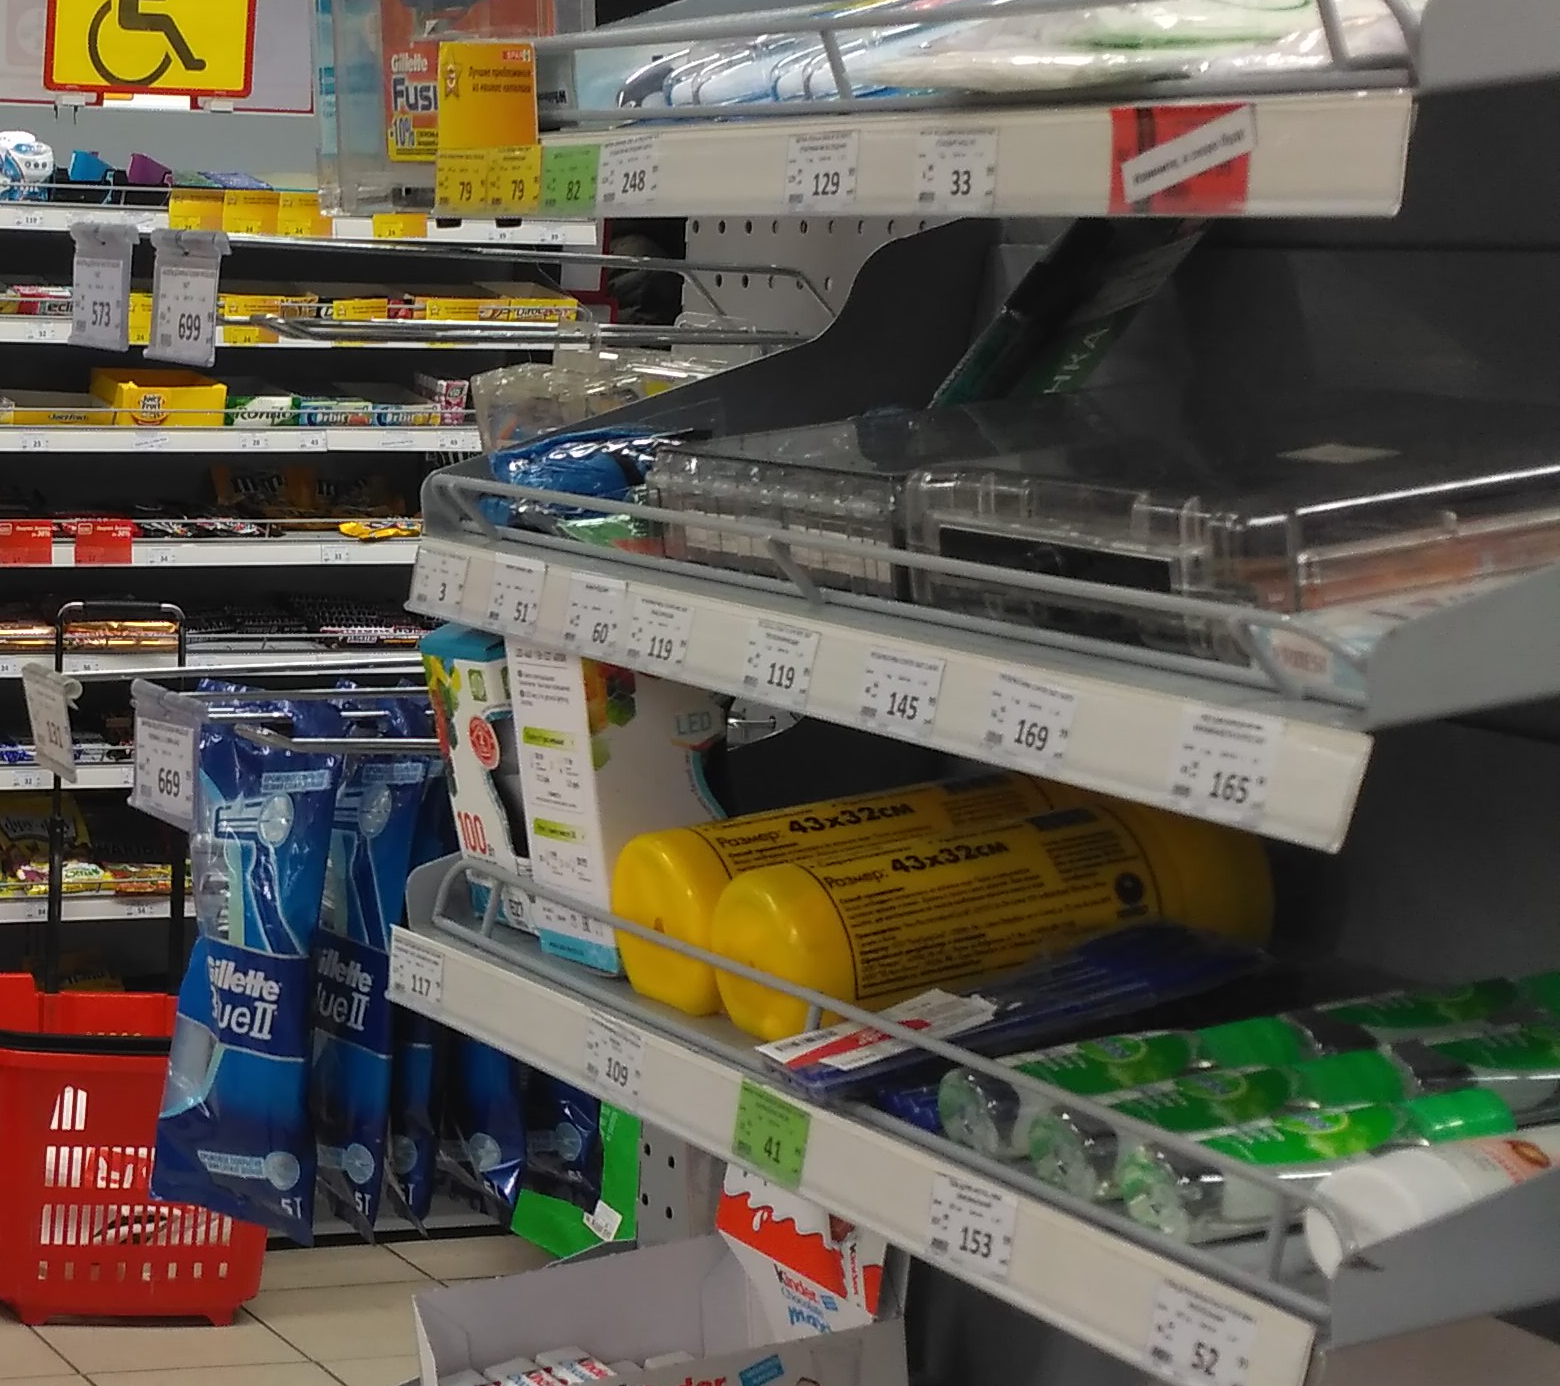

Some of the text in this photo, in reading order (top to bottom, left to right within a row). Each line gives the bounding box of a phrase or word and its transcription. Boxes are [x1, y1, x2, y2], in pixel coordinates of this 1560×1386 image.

[391, 52, 428, 74] Gillette
[390, 115, 416, 149] -10%
[459, 180, 472, 201] 79
[511, 178, 525, 202] 79
[566, 179, 581, 200] 82
[621, 170, 646, 194] 248
[813, 171, 840, 196] 129
[950, 170, 972, 196] 33
[91, 301, 111, 328] 573
[178, 314, 201, 341] 699
[439, 582, 447, 603] 3
[513, 600, 529, 624] 51
[591, 621, 609, 645] 60
[647, 634, 673, 662] 119
[766, 661, 796, 690] 119
[886, 692, 920, 722] 145
[676, 712, 713, 737] LED
[1014, 719, 1048, 752] 169
[156, 766, 181, 798] 669
[1209, 770, 1249, 805] 165
[457, 812, 487, 855] 100
[717, 829, 783, 849] Размер:
[823, 868, 888, 890] Размер:
[315, 948, 375, 995] illette
[410, 974, 431, 997] 117
[605, 1056, 629, 1087] 109
[762, 1136, 782, 1164] 41
[959, 1225, 993, 1258] 153
[773, 1264, 819, 1303] Kinder
[1191, 1341, 1220, 1377] 52
